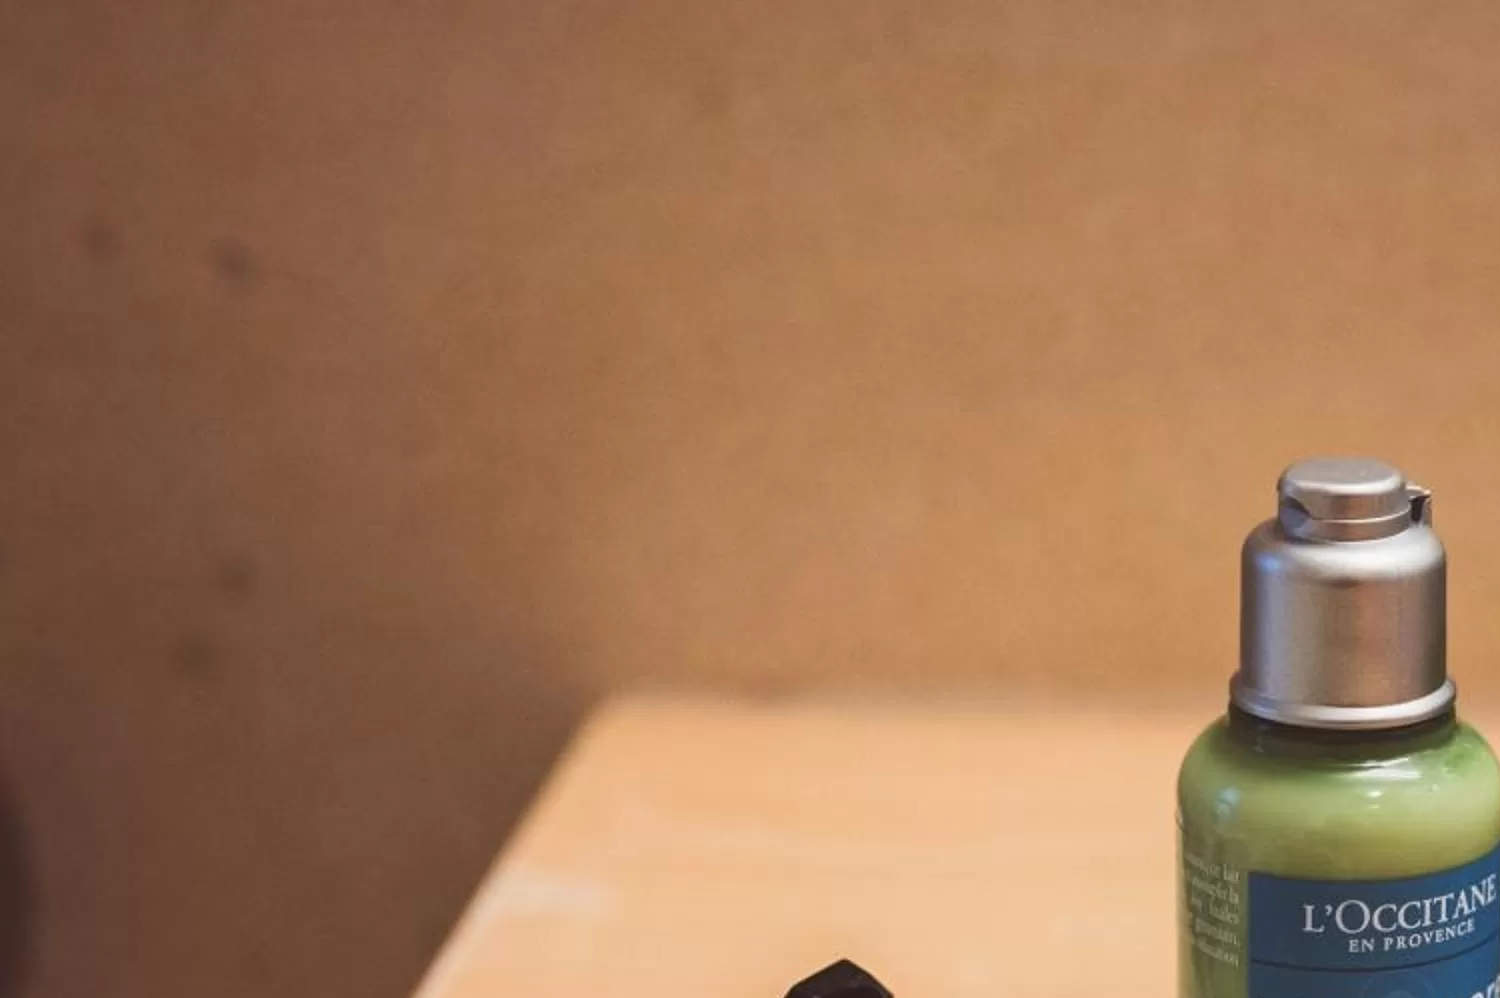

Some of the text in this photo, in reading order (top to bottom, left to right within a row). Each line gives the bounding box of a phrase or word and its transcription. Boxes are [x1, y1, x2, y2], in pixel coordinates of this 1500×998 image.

[1302, 873, 1498, 935] L'OCCITANE
[1348, 916, 1476, 954] EN PROVENCE
